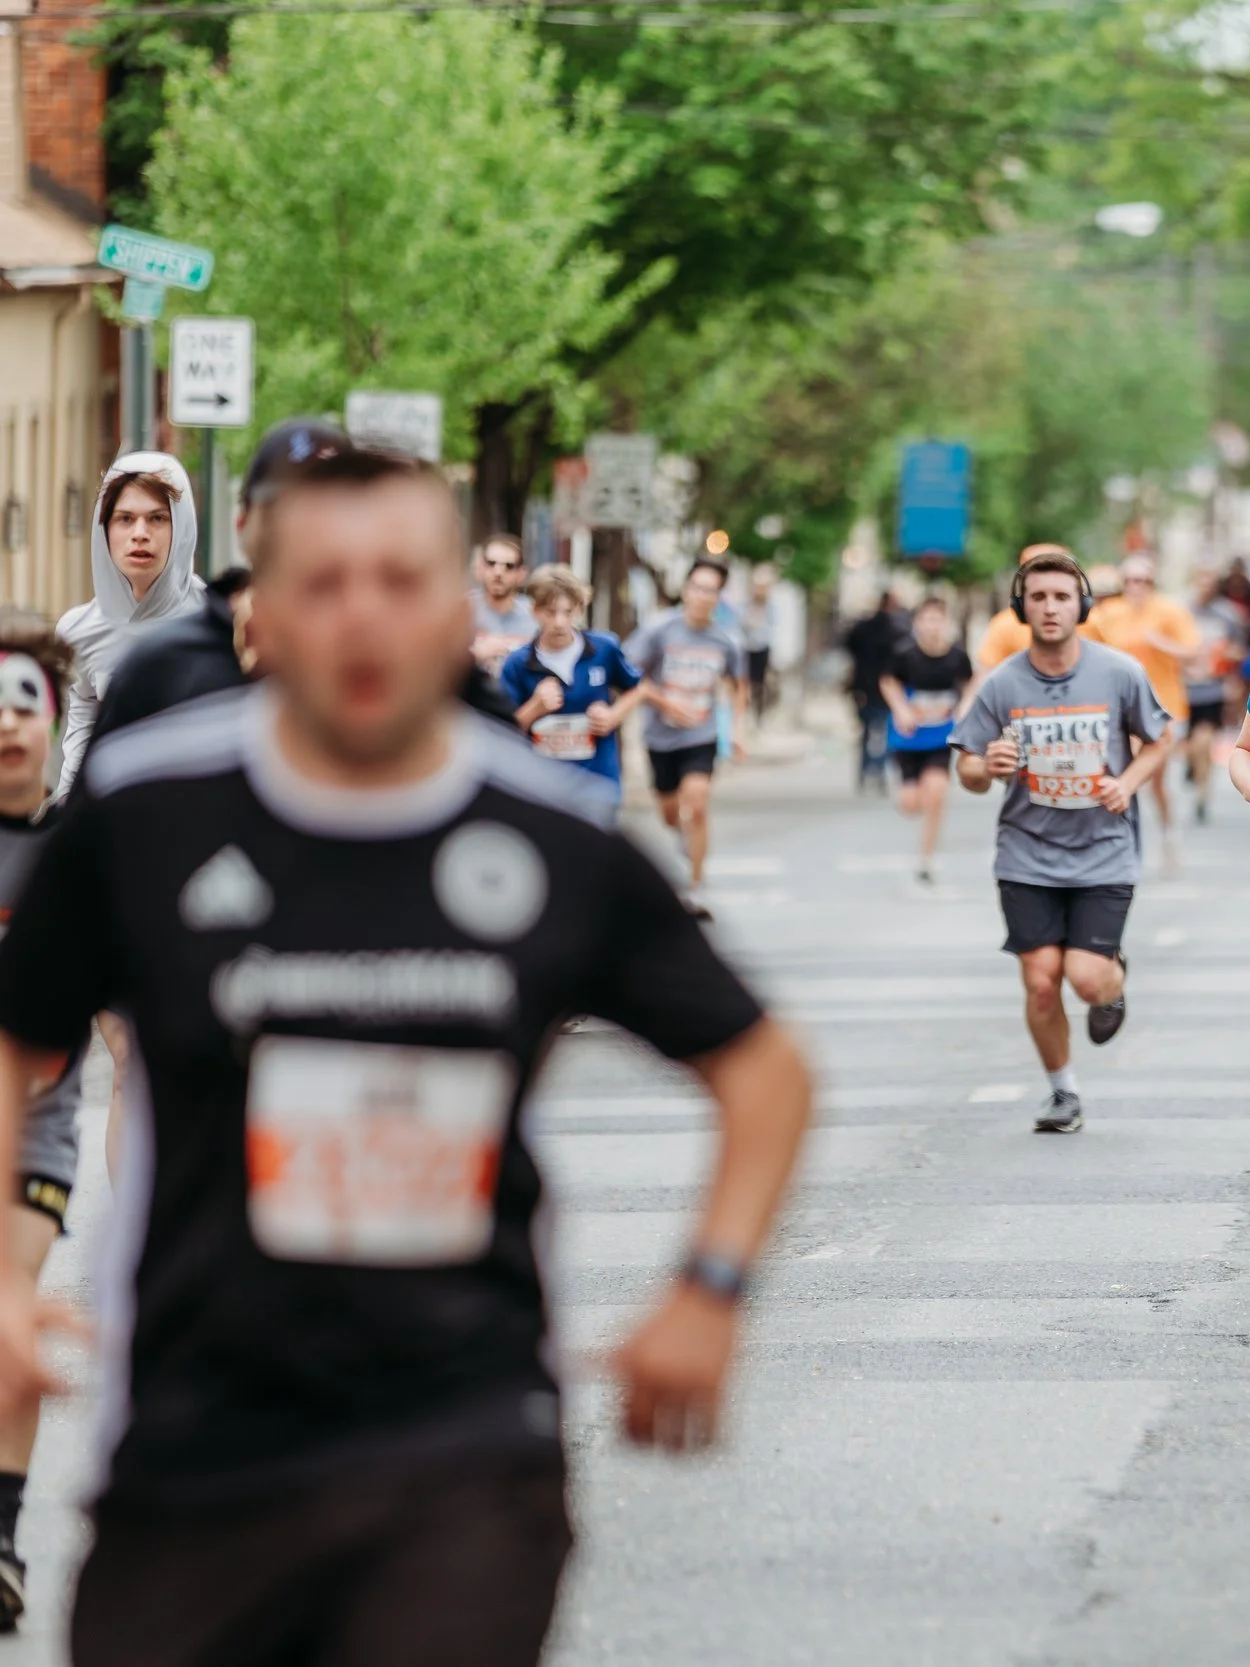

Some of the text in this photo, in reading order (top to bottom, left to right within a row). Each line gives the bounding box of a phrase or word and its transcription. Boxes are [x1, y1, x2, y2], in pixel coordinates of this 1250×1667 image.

[115, 239, 190, 279] SHIPPEN
[181, 333, 236, 352] ONE
[184, 361, 236, 379] WAY
[1038, 776, 1093, 797] 1930
